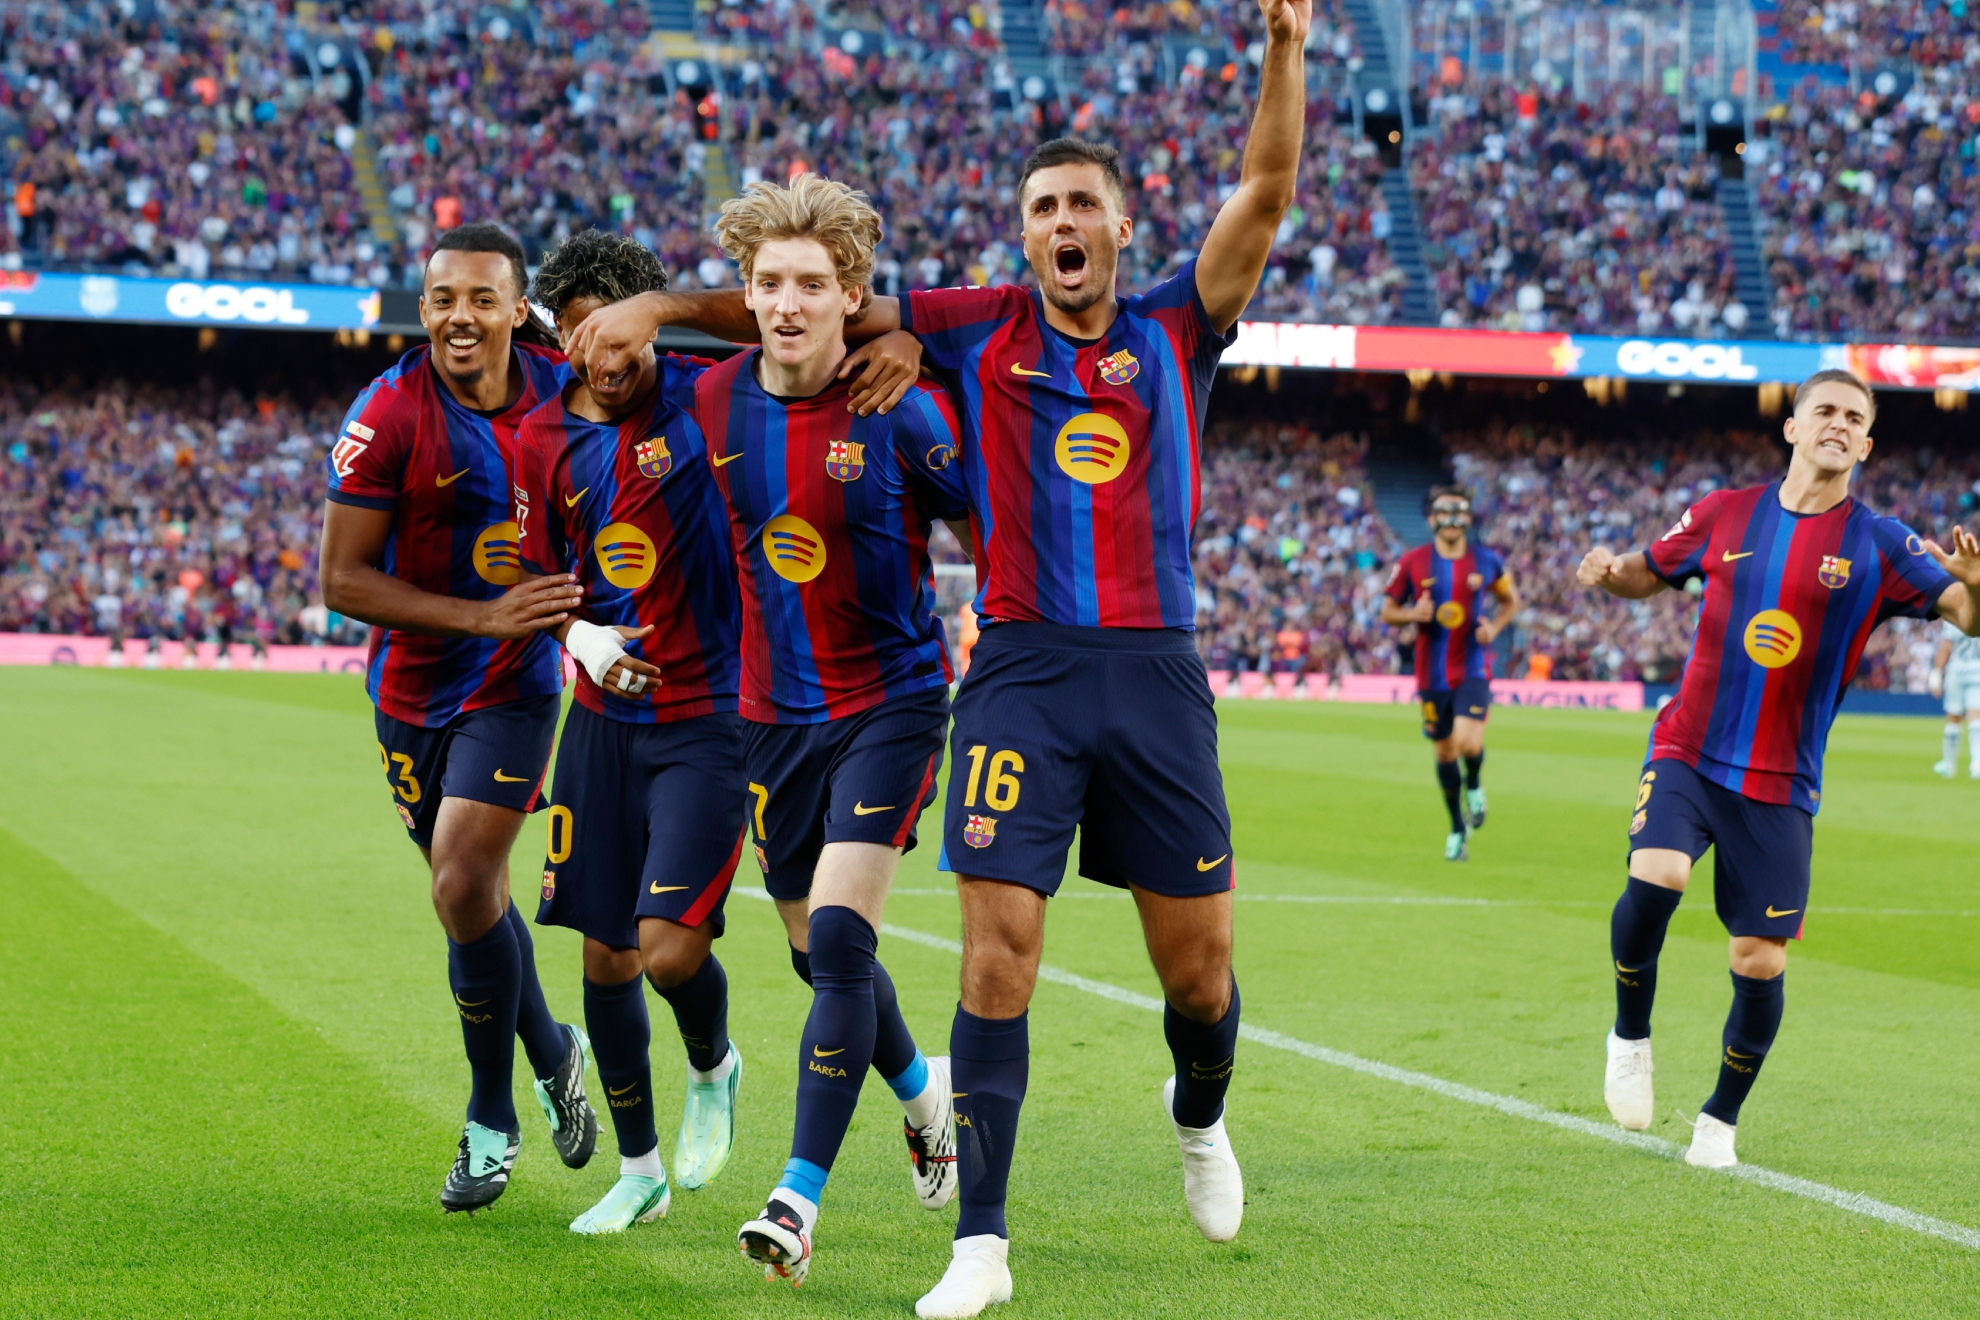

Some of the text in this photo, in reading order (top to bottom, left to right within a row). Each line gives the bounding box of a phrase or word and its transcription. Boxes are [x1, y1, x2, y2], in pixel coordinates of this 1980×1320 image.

[963, 745, 1025, 812] 16
[1634, 770, 1657, 811] 6
[748, 781, 769, 841] 7
[1616, 973, 1640, 987] ARÇA
[809, 1060, 848, 1078] BARÇA
[610, 1095, 643, 1108] BARÇA
